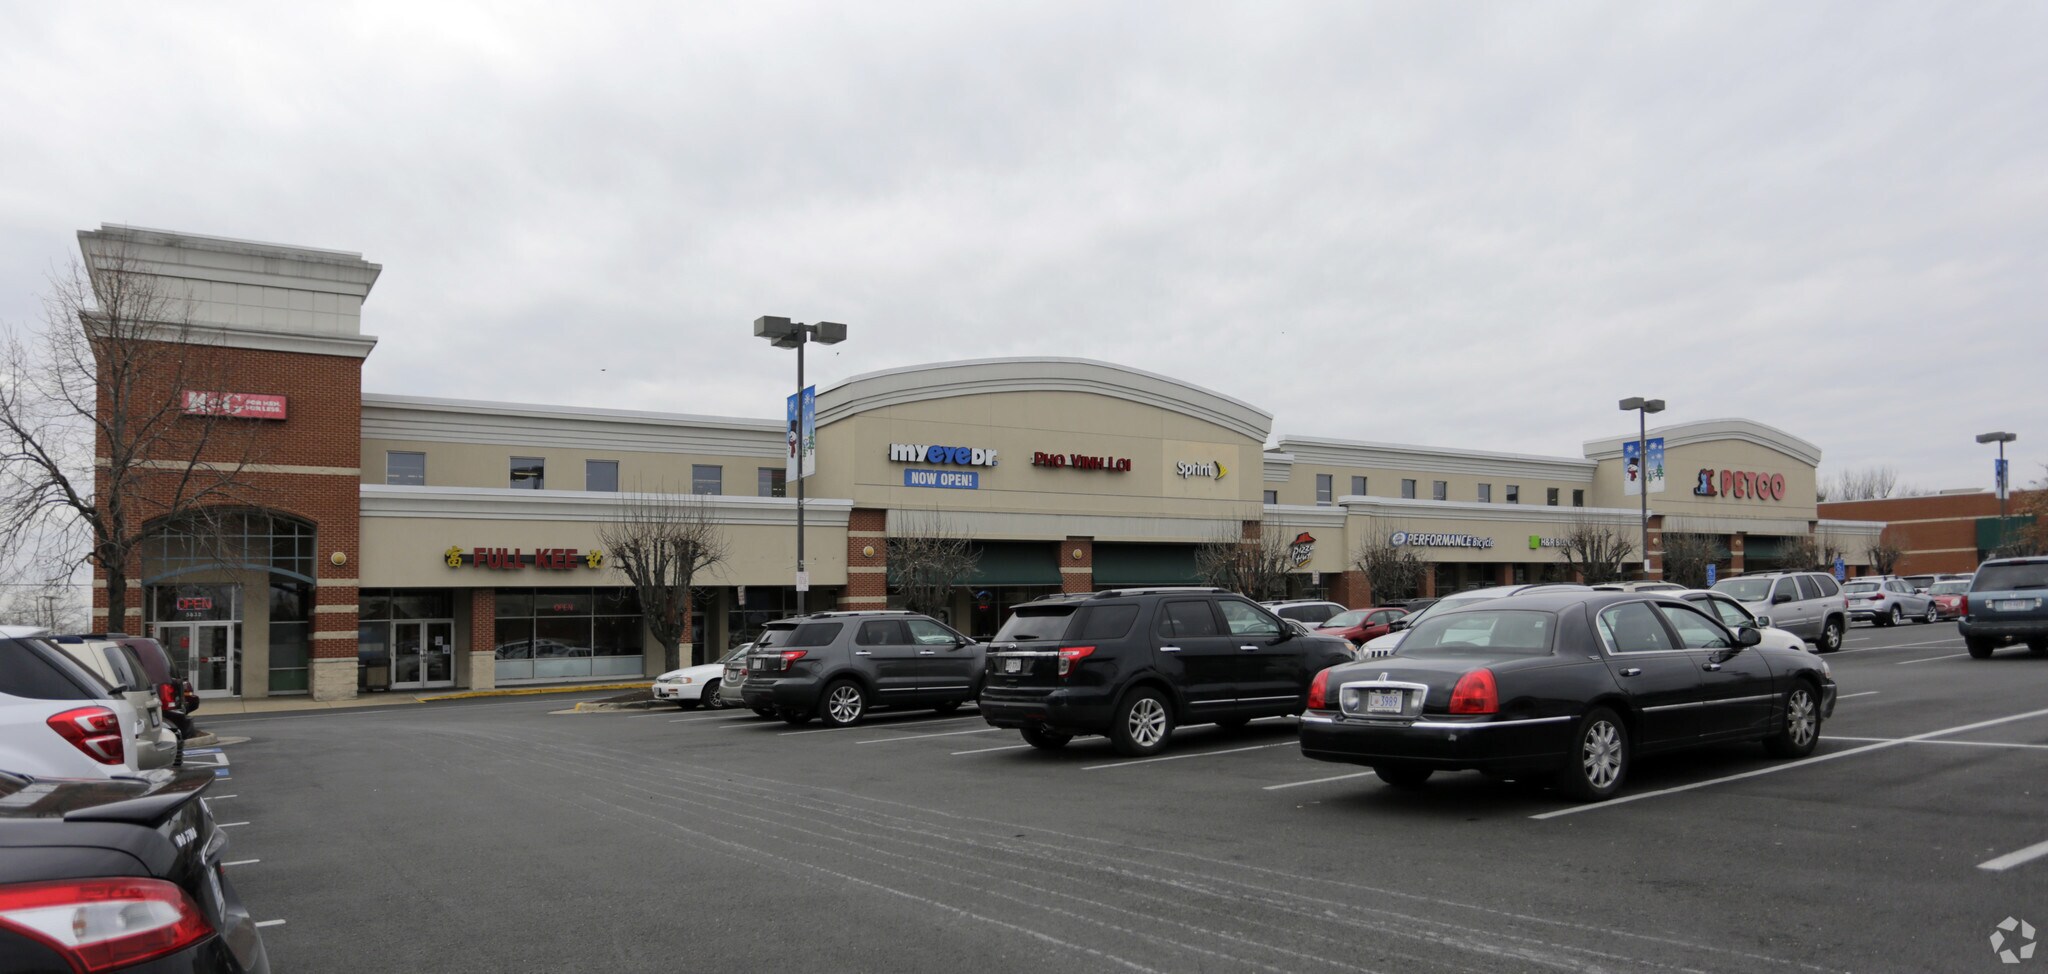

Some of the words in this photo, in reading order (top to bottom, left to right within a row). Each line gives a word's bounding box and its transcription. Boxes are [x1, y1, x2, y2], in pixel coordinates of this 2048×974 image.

[1033, 452, 1066, 468] PHO
[1070, 454, 1104, 470] VINH
[1108, 456, 1131, 471] LOI
[1177, 460, 1213, 479] Sprint
[911, 471, 937, 485] NOW
[940, 473, 973, 487] OPEN!
[1720, 470, 1786, 500] PETCO
[1406, 533, 1472, 547] PERFORMANCE
[1472, 537, 1494, 549] Bicycle
[474, 547, 525, 569] FULL
[535, 548, 578, 569] KEE
[178, 598, 212, 609] OPEN
